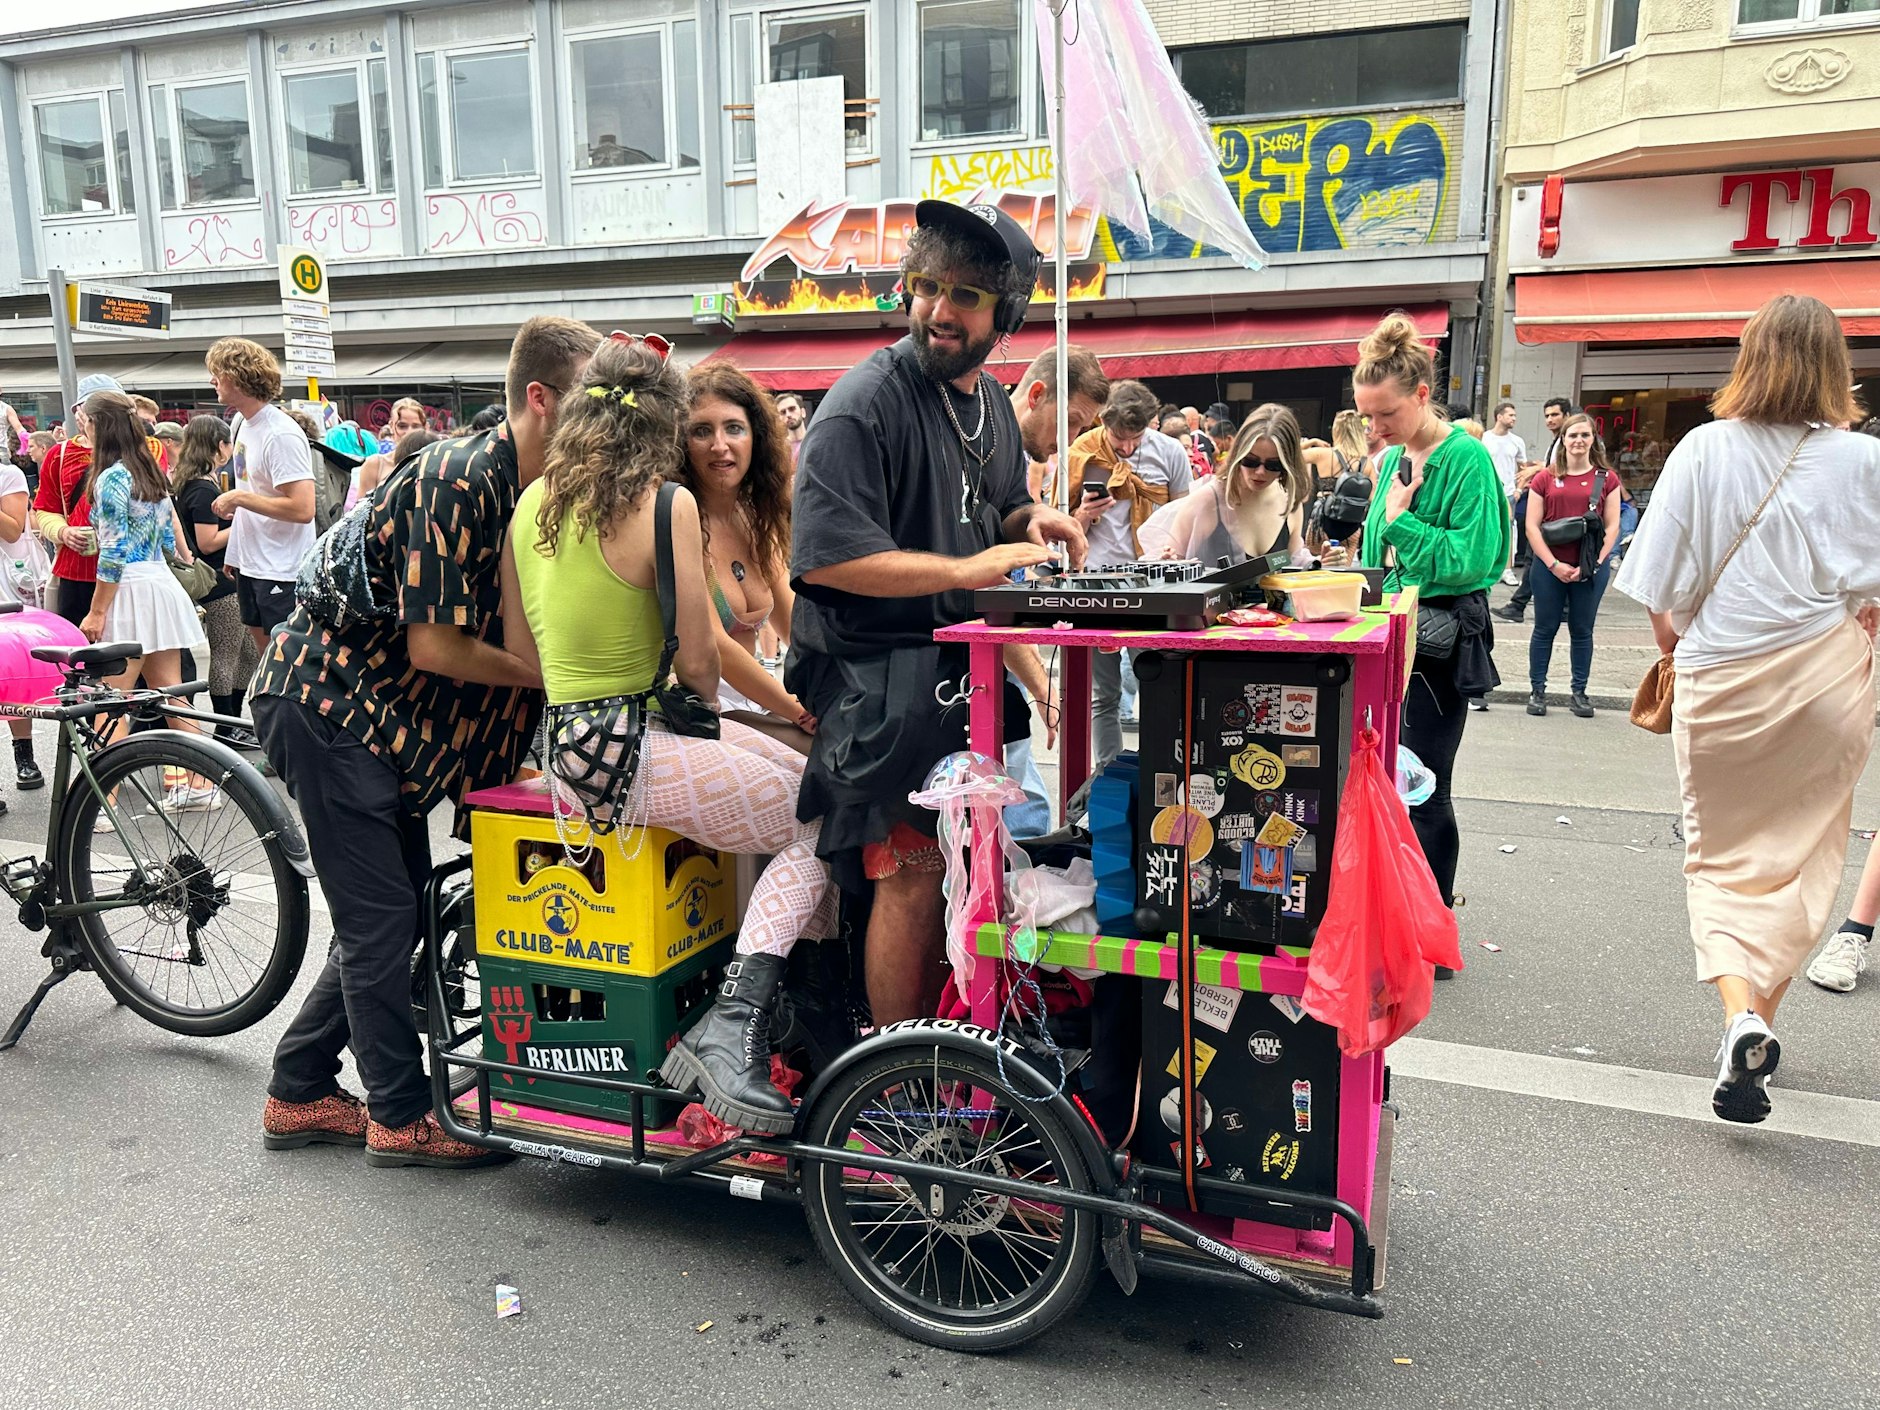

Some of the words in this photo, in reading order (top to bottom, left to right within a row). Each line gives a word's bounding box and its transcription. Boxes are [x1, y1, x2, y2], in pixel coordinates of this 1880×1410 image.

[300, 263, 316, 286] H
[703, 298, 713, 308] EC
[1029, 596, 1107, 609] DENON
[1112, 596, 1143, 609] DJ
[1188, 798, 1215, 806] PLANE
[1284, 792, 1294, 820] THINK
[1296, 799, 1305, 822] KINK
[1217, 827, 1255, 840] BLOODY
[507, 894, 522, 903] DER
[523, 882, 567, 903] PRICKELNDE
[569, 888, 616, 914] MATE-EISTEE
[665, 901, 675, 911] DER
[495, 929, 631, 965] CLUB-MATE
[666, 917, 725, 959] CLUB-MATE
[880, 1018, 1025, 1057] VELOGUT
[1250, 1037, 1282, 1049] TRIP
[1254, 1044, 1279, 1056] THE
[525, 1045, 629, 1073] BERLINER
[854, 1060, 909, 1088] SCHWALBE
[927, 1058, 975, 1072] PCK-UP
[510, 1140, 548, 1158] CARLA
[563, 1149, 602, 1168] CARGO
[1262, 1131, 1282, 1174] REFUGEES
[1280, 1140, 1301, 1181] WELCOME
[1196, 1235, 1237, 1264] CARLA
[1238, 1255, 1281, 1284] CARGO
